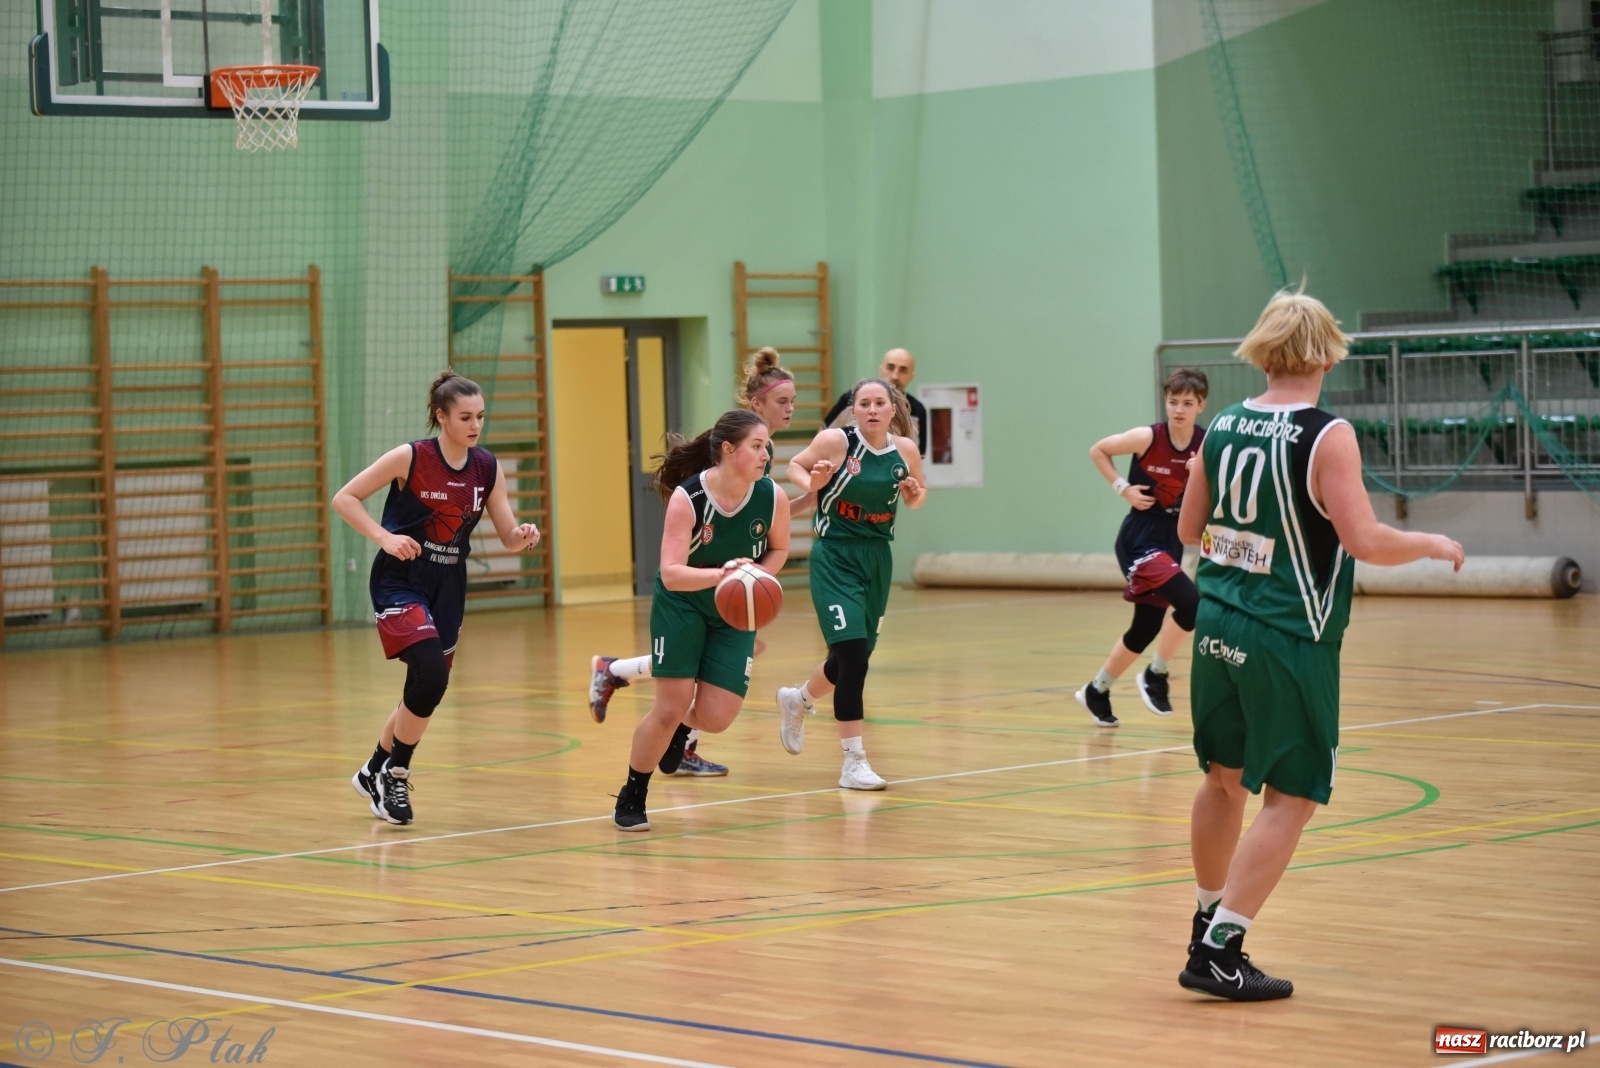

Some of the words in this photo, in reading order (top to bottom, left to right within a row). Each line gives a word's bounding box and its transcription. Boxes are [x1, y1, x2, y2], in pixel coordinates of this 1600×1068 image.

[421, 490, 429, 499] UKS
[1213, 443, 1266, 524] 10
[828, 604, 847, 631] 3
[654, 636, 665, 665] 4
